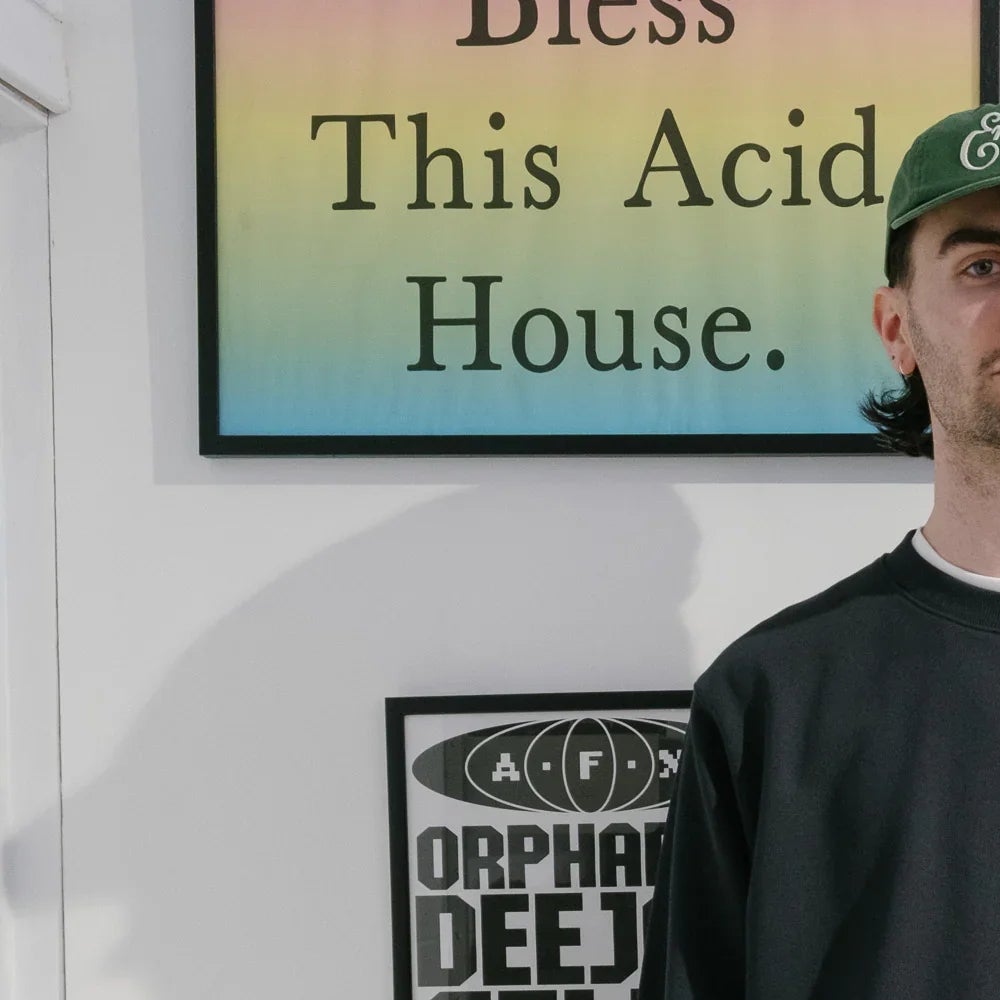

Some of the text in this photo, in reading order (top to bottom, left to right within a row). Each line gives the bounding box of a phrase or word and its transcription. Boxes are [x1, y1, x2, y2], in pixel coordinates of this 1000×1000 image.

[310, 104, 885, 210] This Acid
[405, 274, 787, 372] House.
[415, 892, 654, 987] DEEJ
